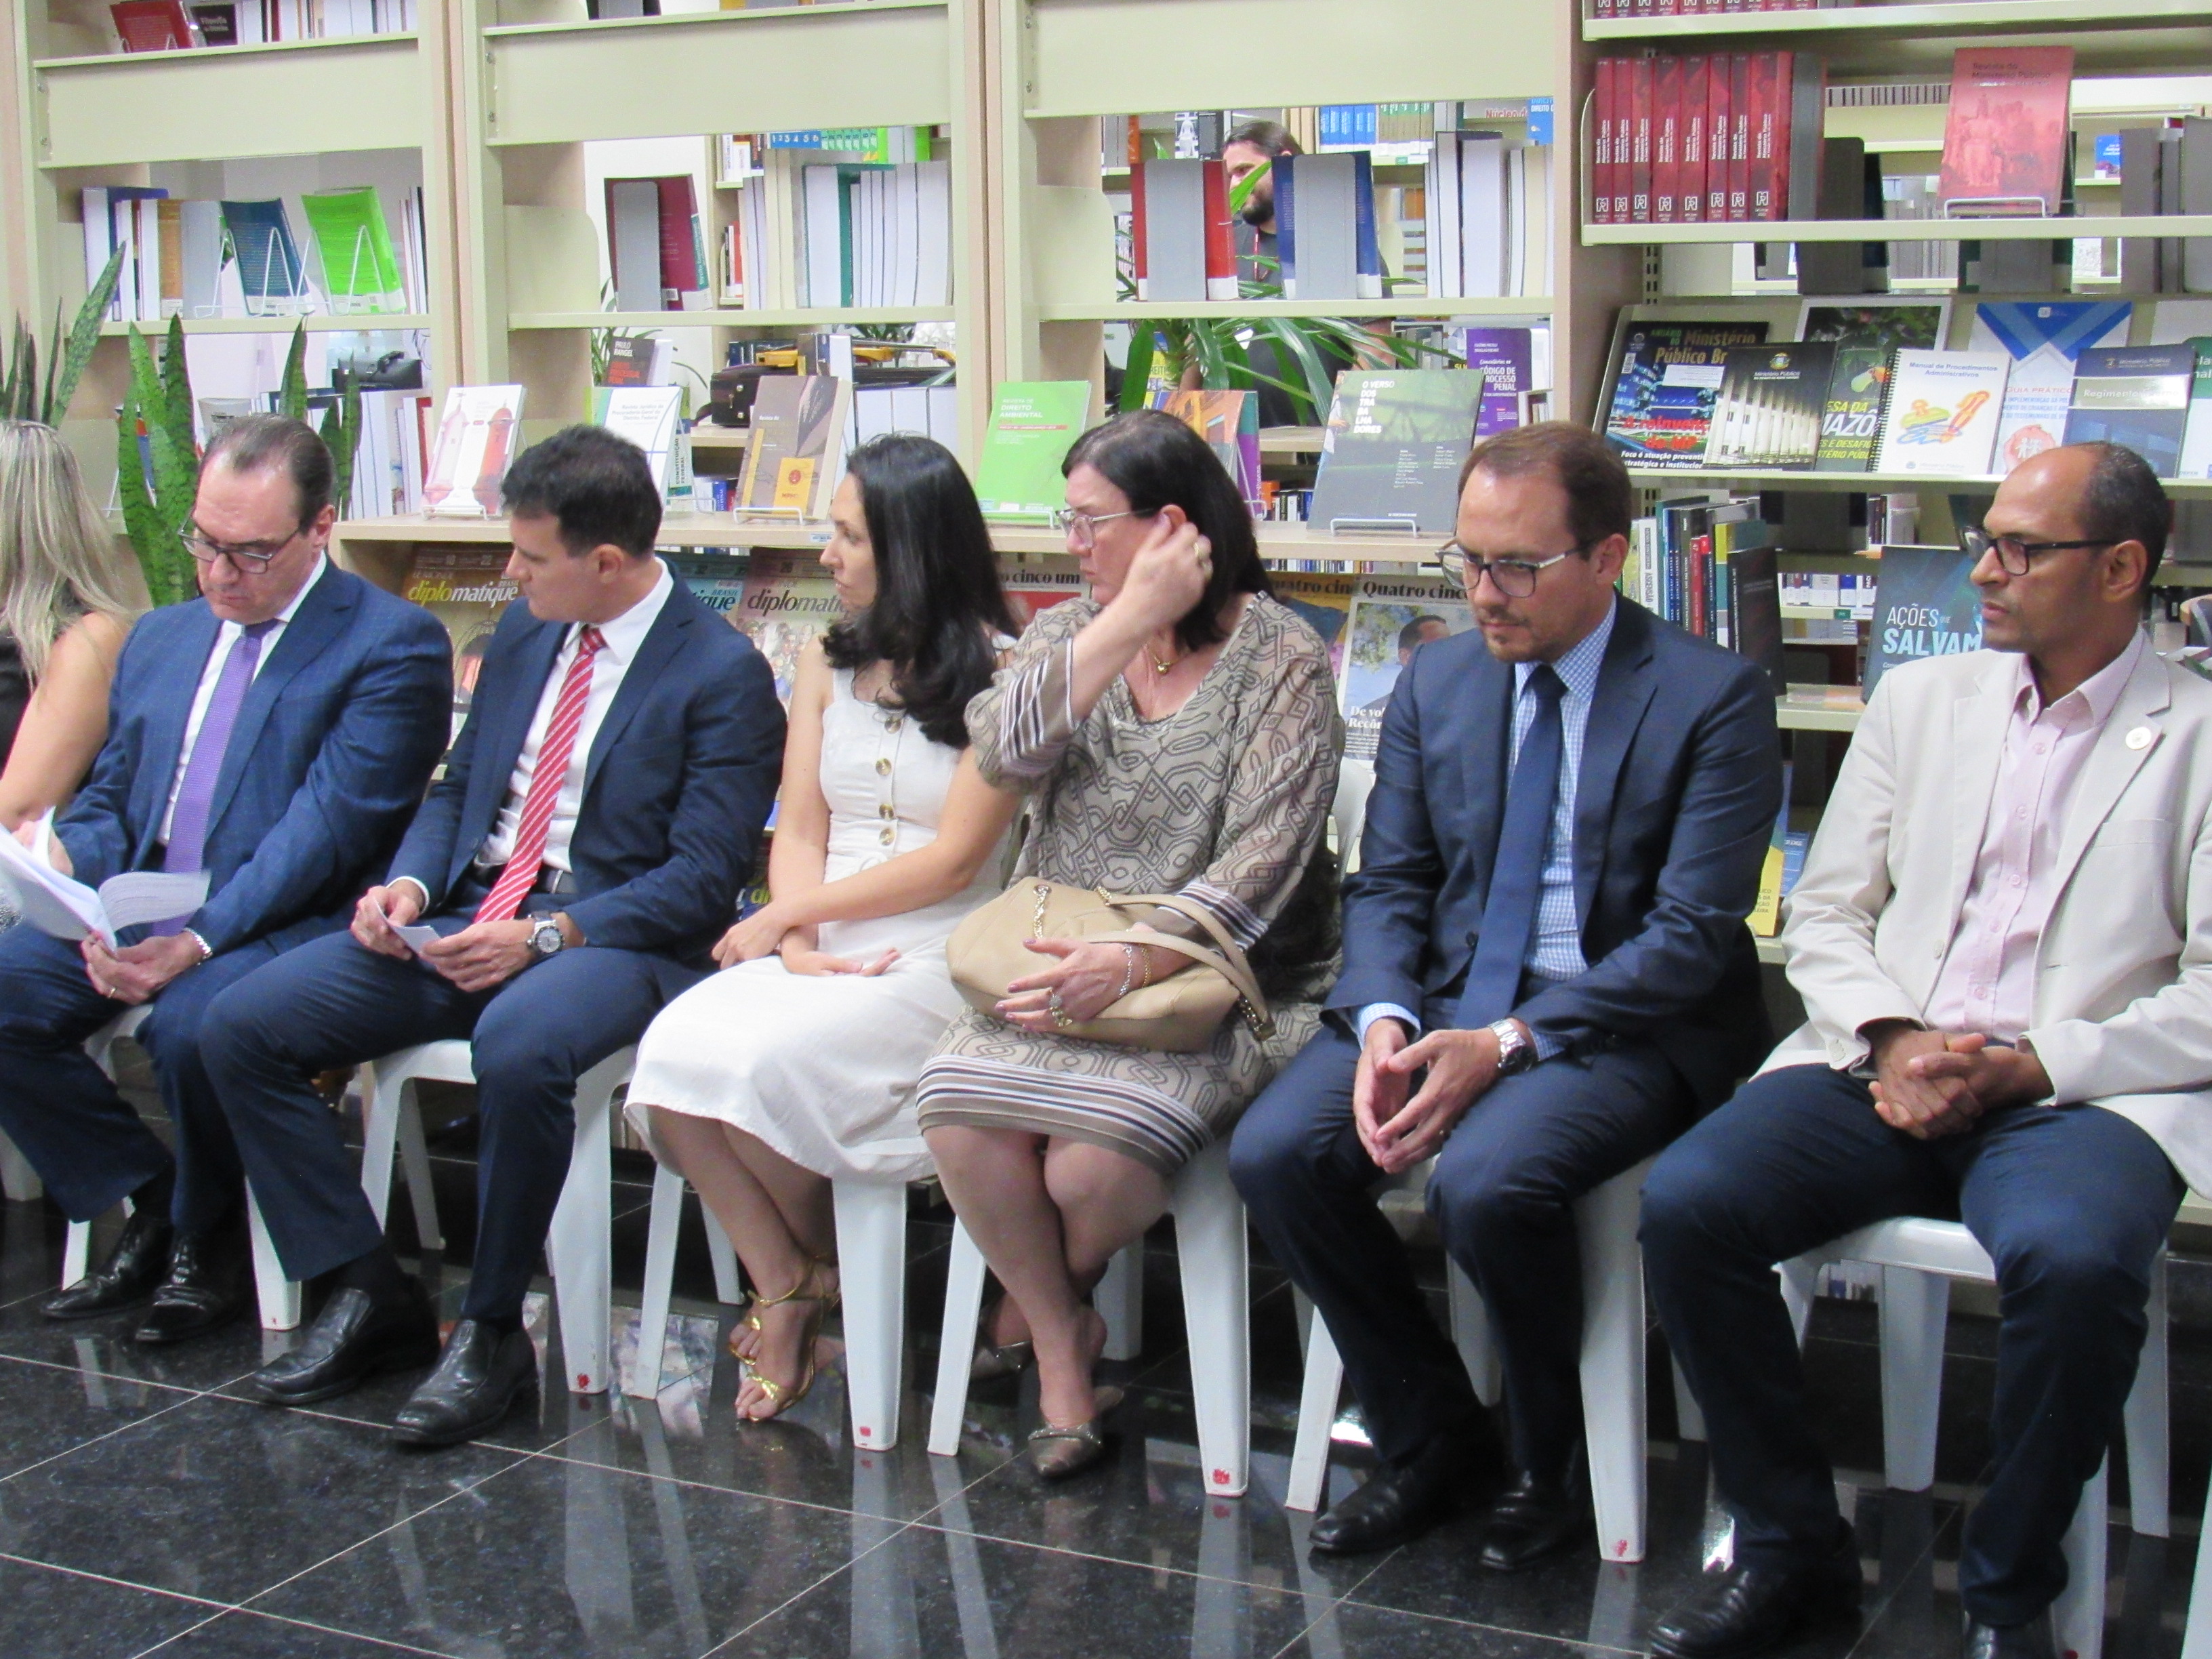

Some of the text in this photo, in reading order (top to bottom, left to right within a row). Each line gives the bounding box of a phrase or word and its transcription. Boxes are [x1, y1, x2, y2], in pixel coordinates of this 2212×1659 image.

[1683, 329, 1757, 346] Ministério
[1655, 346, 1707, 364] Público
[1507, 366, 1516, 375] DE
[1925, 369, 1979, 377] Administrativos
[1370, 380, 1395, 388] VERSO
[1494, 383, 1517, 391] PENAL
[1360, 389, 1376, 398] DOS
[1359, 398, 1375, 407] TRA
[1851, 401, 1869, 413] DA
[1353, 425, 1382, 434] DORES
[1645, 434, 1698, 450] do MP
[1644, 453, 1672, 461] atuação
[1012, 569, 1080, 584] cinco um
[408, 579, 518, 609] diplomatique
[1363, 580, 1426, 598] Quatro
[1885, 602, 1940, 630] AÇÕES
[1882, 628, 1983, 657] SALVAM
[1351, 706, 1368, 716] De
